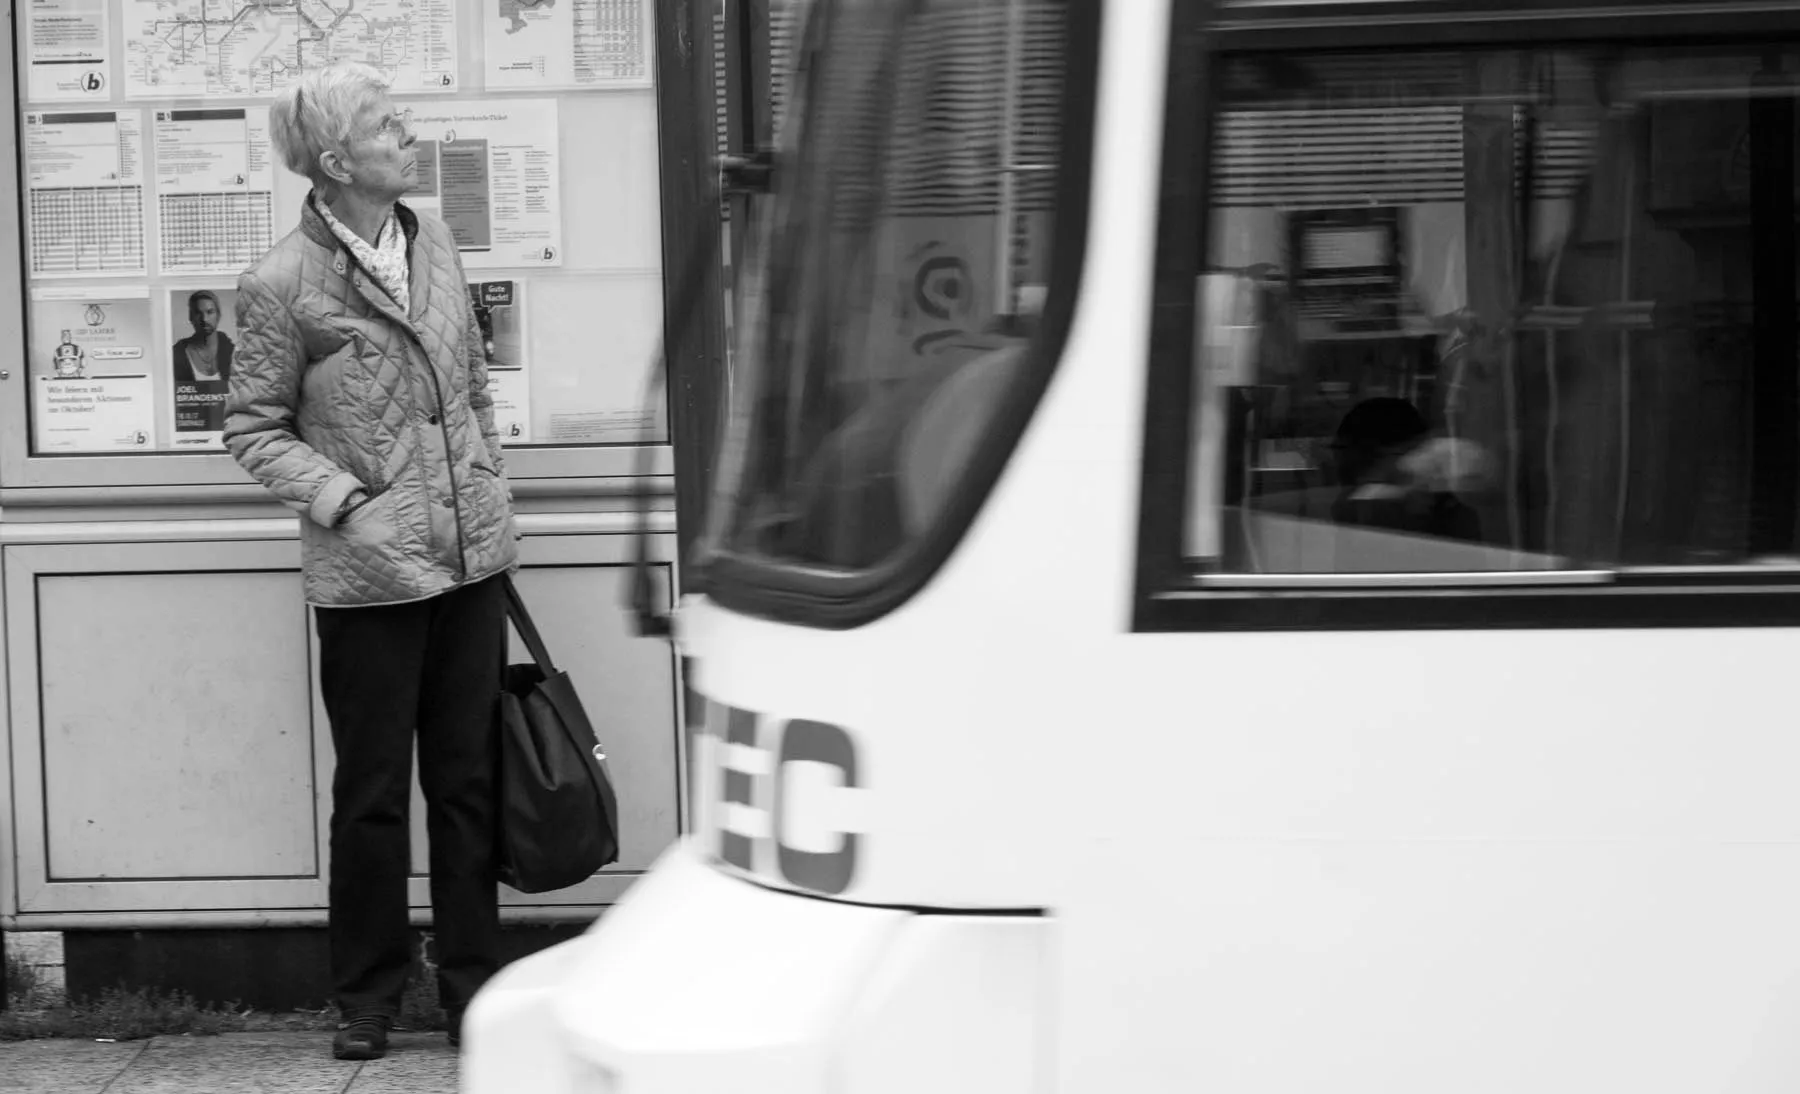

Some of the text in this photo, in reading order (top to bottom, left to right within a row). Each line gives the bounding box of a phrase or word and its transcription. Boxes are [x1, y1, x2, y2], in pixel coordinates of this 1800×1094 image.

[87, 73, 100, 90] b
[488, 285, 505, 293] Gute
[176, 385, 198, 393] JOEL
